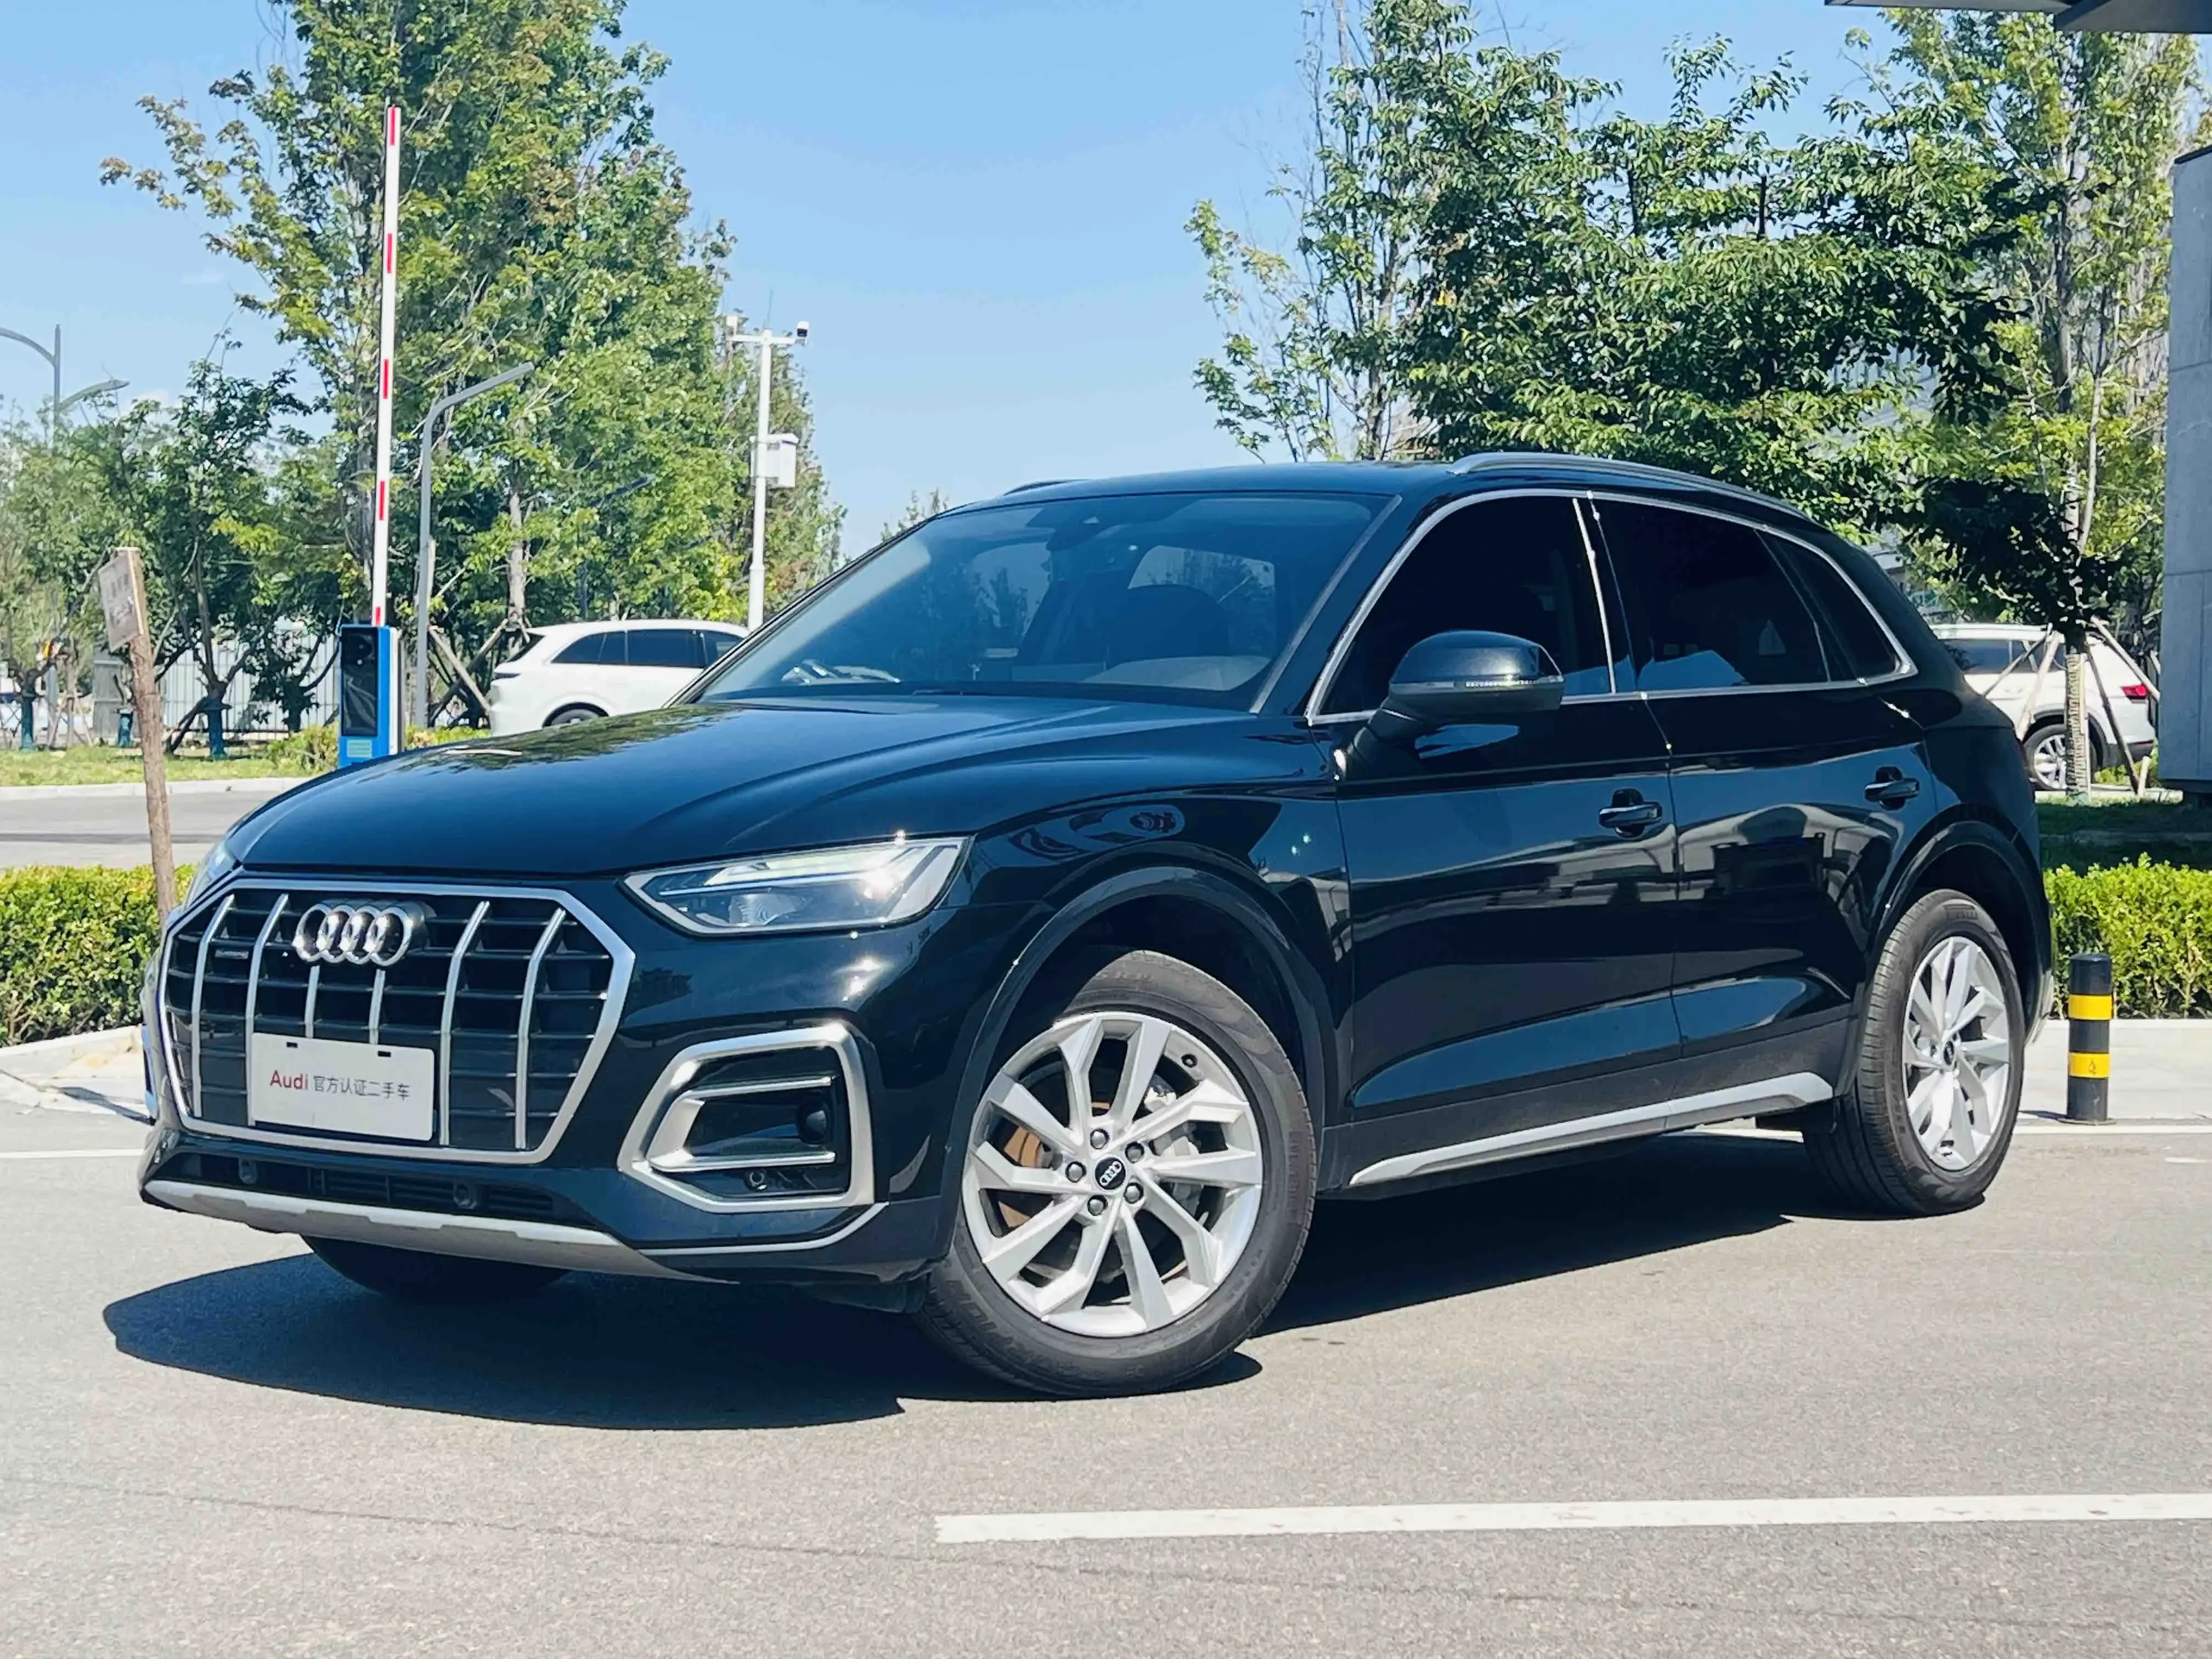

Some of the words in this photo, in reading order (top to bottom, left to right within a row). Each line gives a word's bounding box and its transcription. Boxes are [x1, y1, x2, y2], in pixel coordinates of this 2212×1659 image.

[269, 1070, 309, 1091] Audi
[313, 1075, 410, 1101] 官方认证二手车
